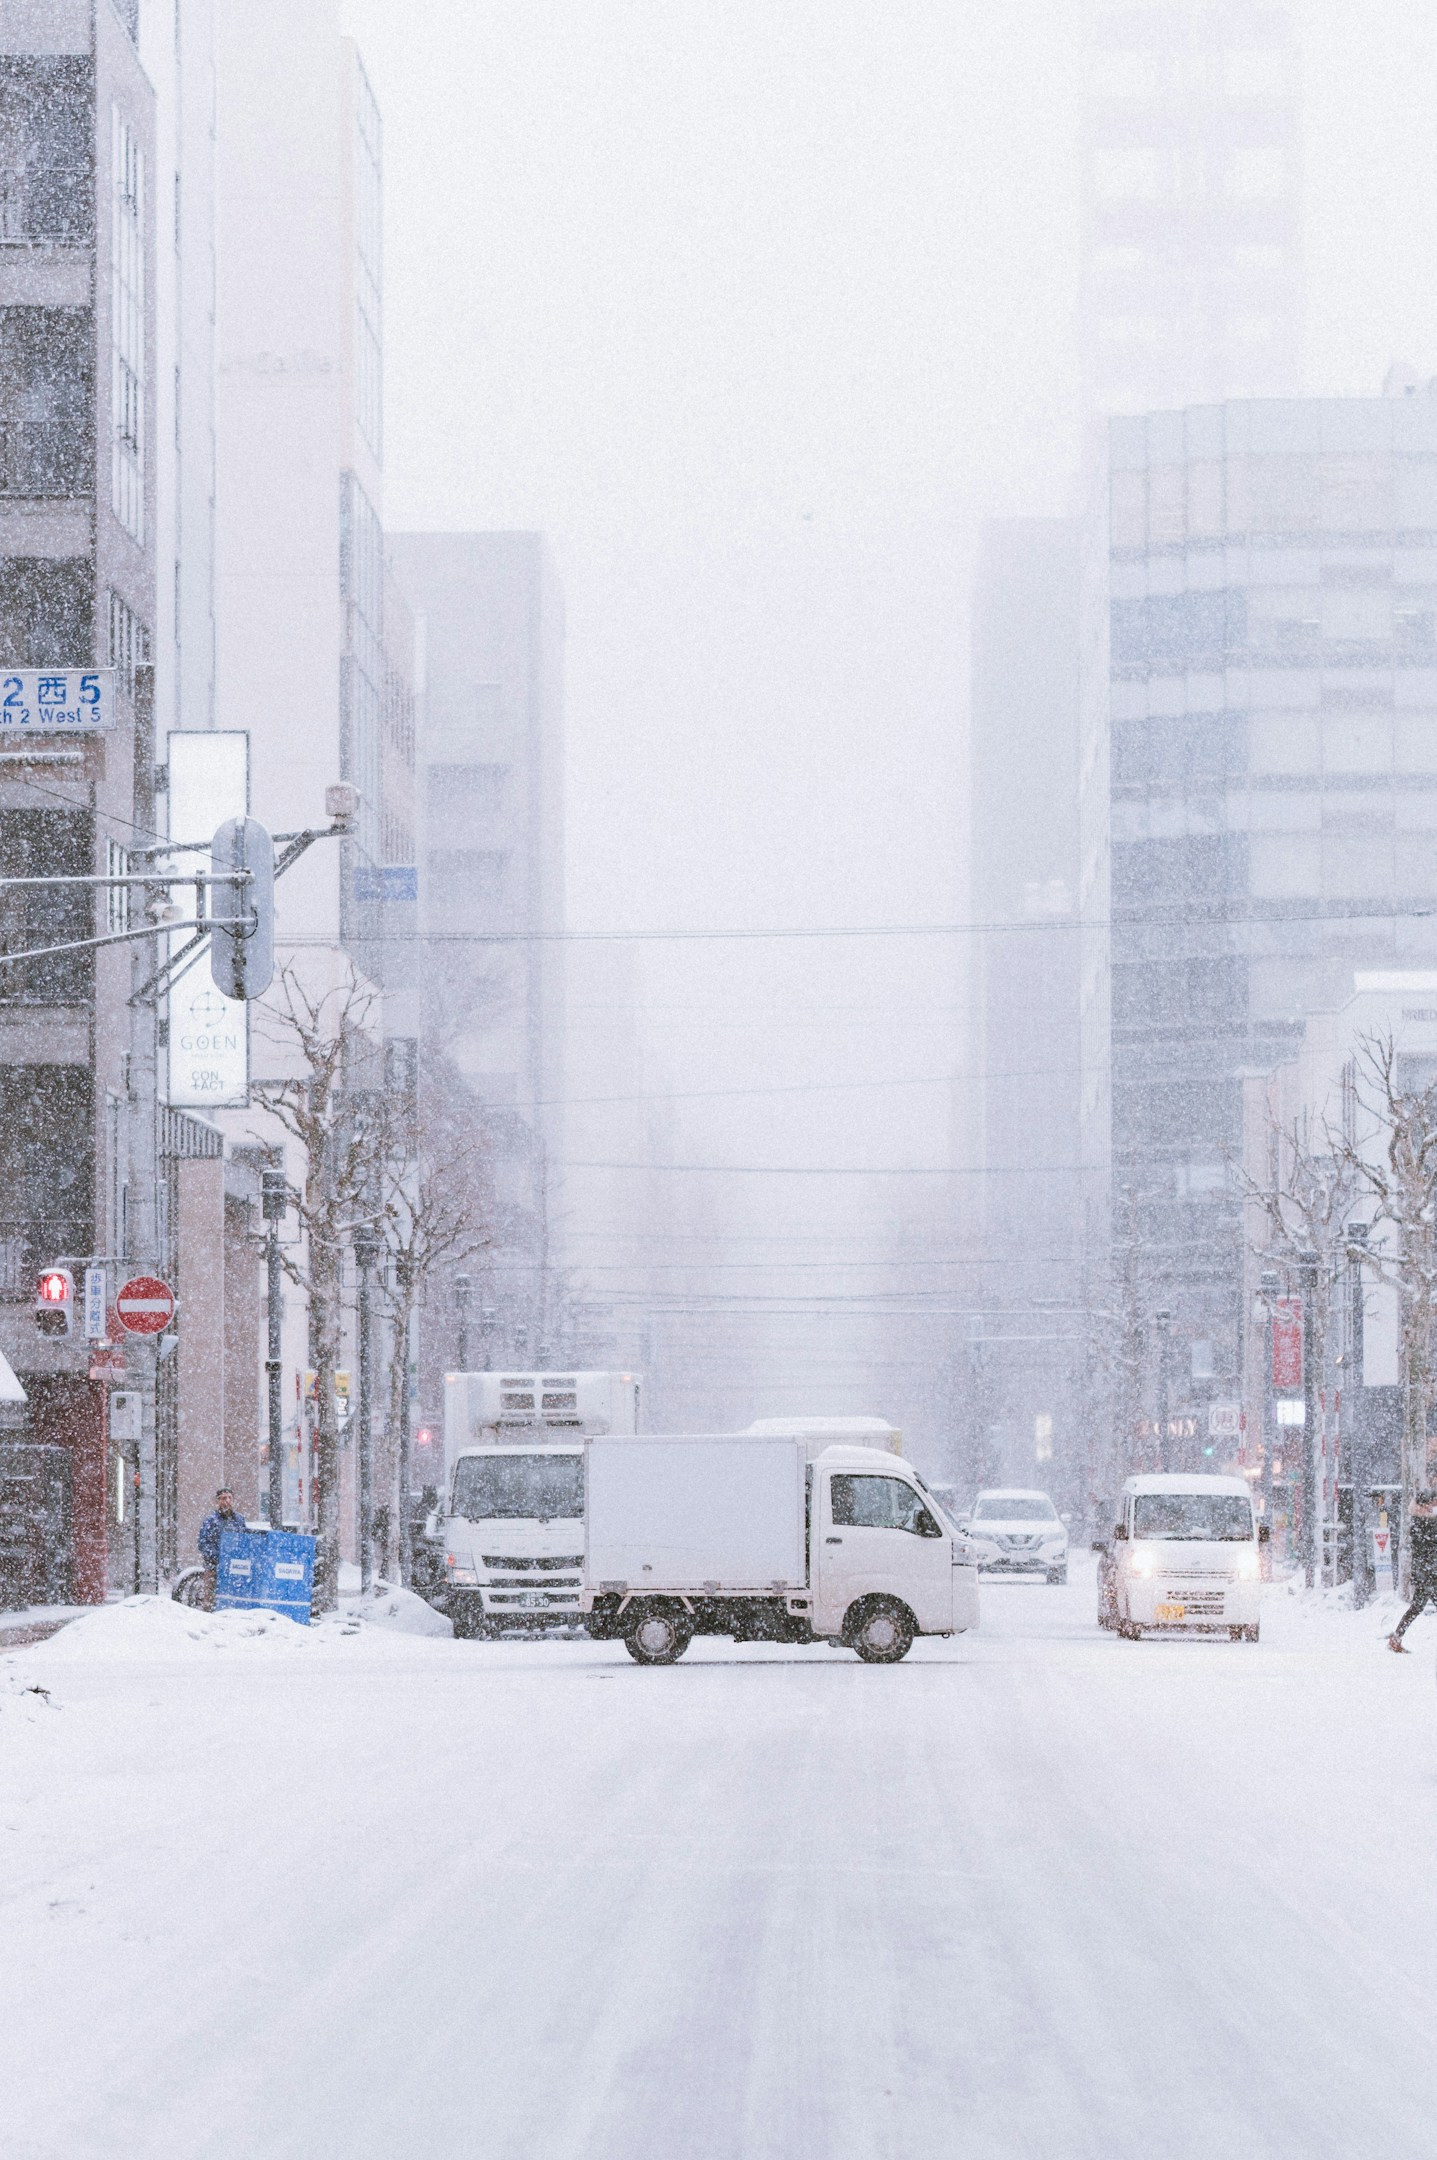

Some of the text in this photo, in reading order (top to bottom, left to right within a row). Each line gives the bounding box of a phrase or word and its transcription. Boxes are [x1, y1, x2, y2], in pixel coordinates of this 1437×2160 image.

[0, 707, 101, 724] h 2 West 5
[180, 1035, 237, 1050] GOEN
[191, 1071, 219, 1081] CON
[89, 1273, 101, 1334] 歩車分離式
